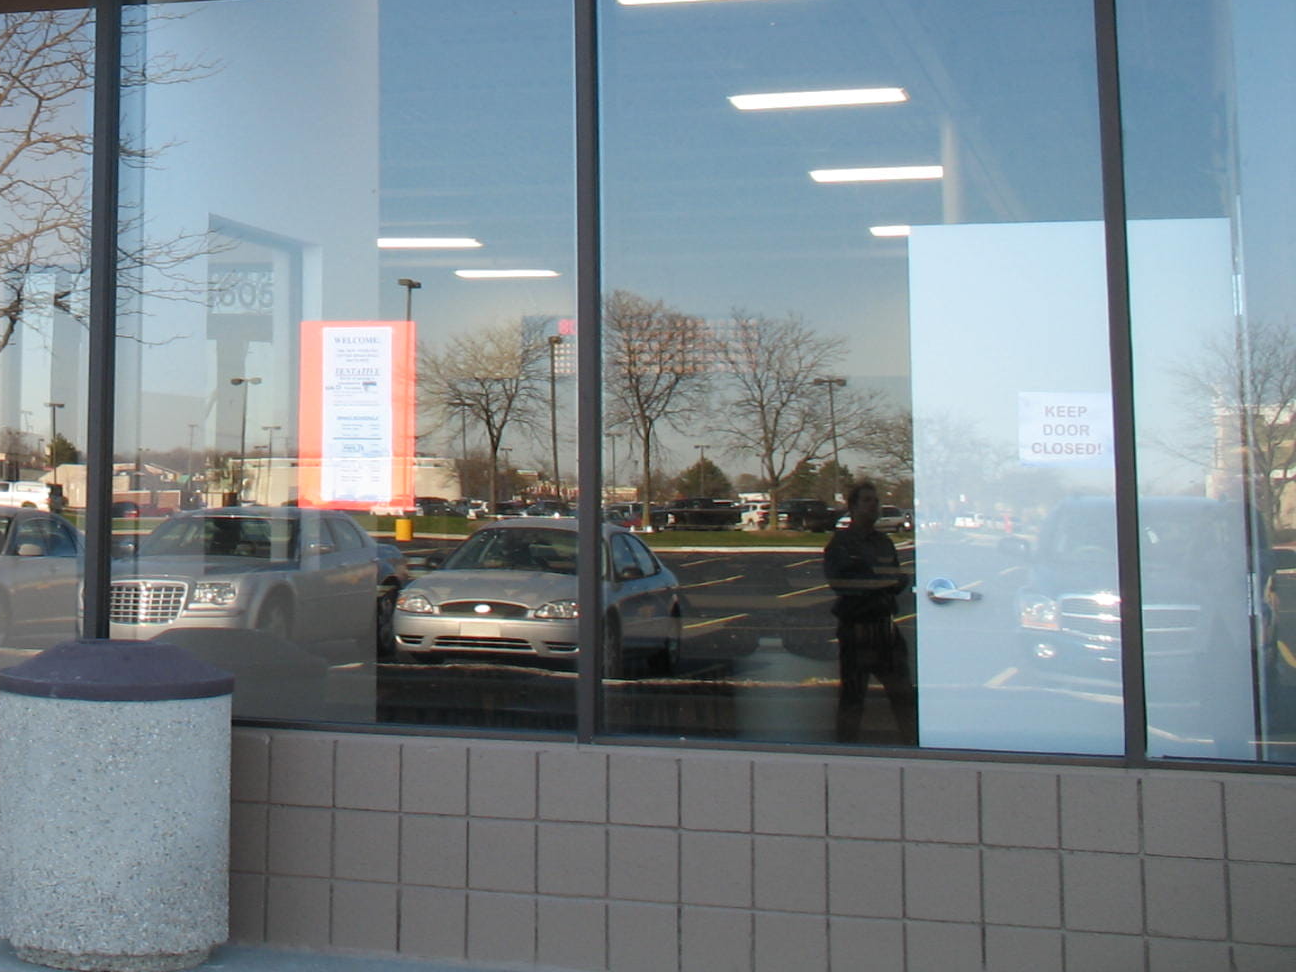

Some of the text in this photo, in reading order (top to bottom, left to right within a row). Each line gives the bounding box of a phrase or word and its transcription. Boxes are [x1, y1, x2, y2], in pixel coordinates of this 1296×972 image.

[1044, 405, 1087, 417] KEEP
[1043, 424, 1090, 436] DOOR
[1031, 442, 1102, 455] CLOSED!
